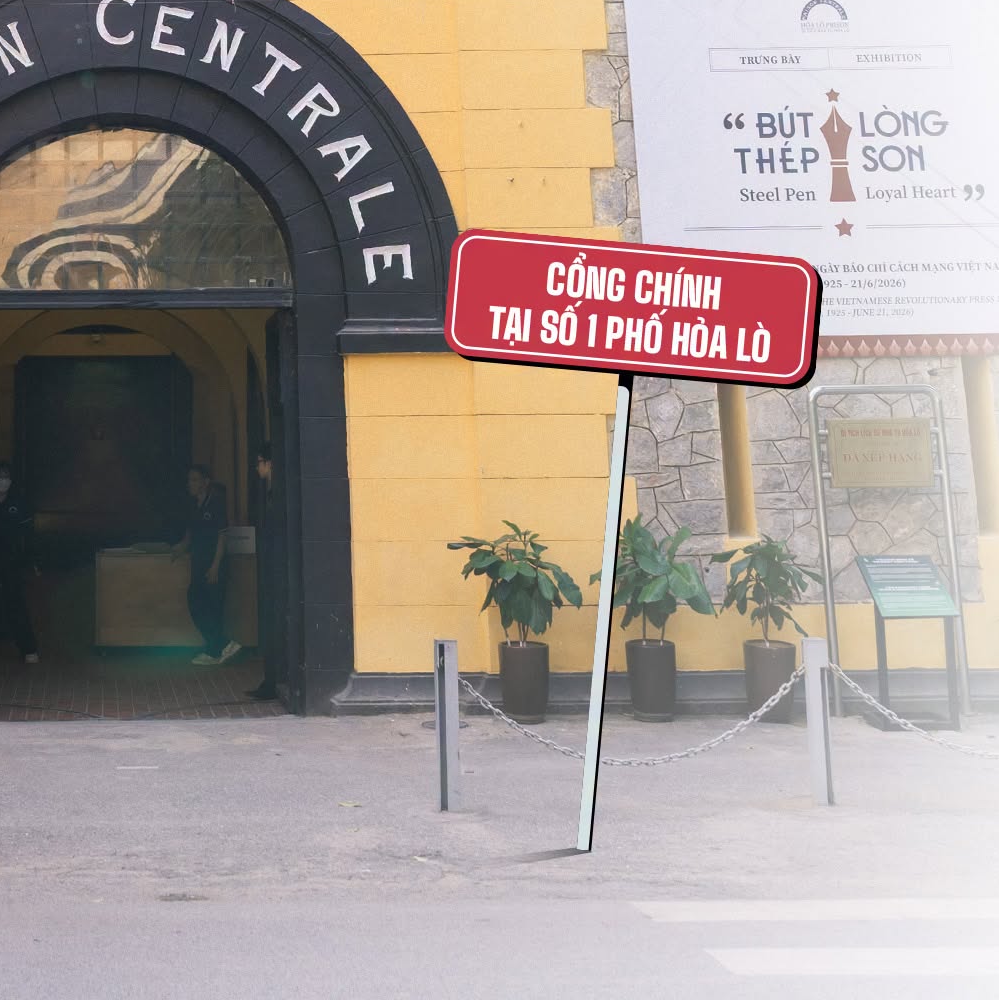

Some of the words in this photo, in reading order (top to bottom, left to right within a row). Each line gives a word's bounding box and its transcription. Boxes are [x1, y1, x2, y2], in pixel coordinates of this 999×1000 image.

[739, 55, 778, 65] TRƯNG
[781, 53, 801, 64] BÀY
[855, 53, 922, 63] EXHIBITION
[756, 105, 814, 139] BÚT
[859, 105, 949, 137] LÒNG
[734, 141, 820, 174] THÉP
[862, 145, 926, 172] SON
[740, 187, 780, 202] Steel
[786, 188, 816, 201] Pen
[865, 186, 907, 202] Loyal
[912, 186, 957, 199] Heart
[843, 262, 865, 272] BÁO
[867, 262, 887, 272] CHÍ
[889, 261, 918, 272] CÁCH
[921, 262, 955, 274] MẠNG
[957, 260, 981, 273] VIỆT
[985, 262, 999, 271] NA
[850, 279, 906, 289] 21/6/2026)
[822, 297, 834, 306] HE
[836, 297, 893, 305] VIETNAMESE
[894, 296, 968, 305] REVOLUTIONARY
[969, 296, 995, 304] PRESS
[827, 309, 846, 317] 1925
[852, 308, 875, 317] JUNE
